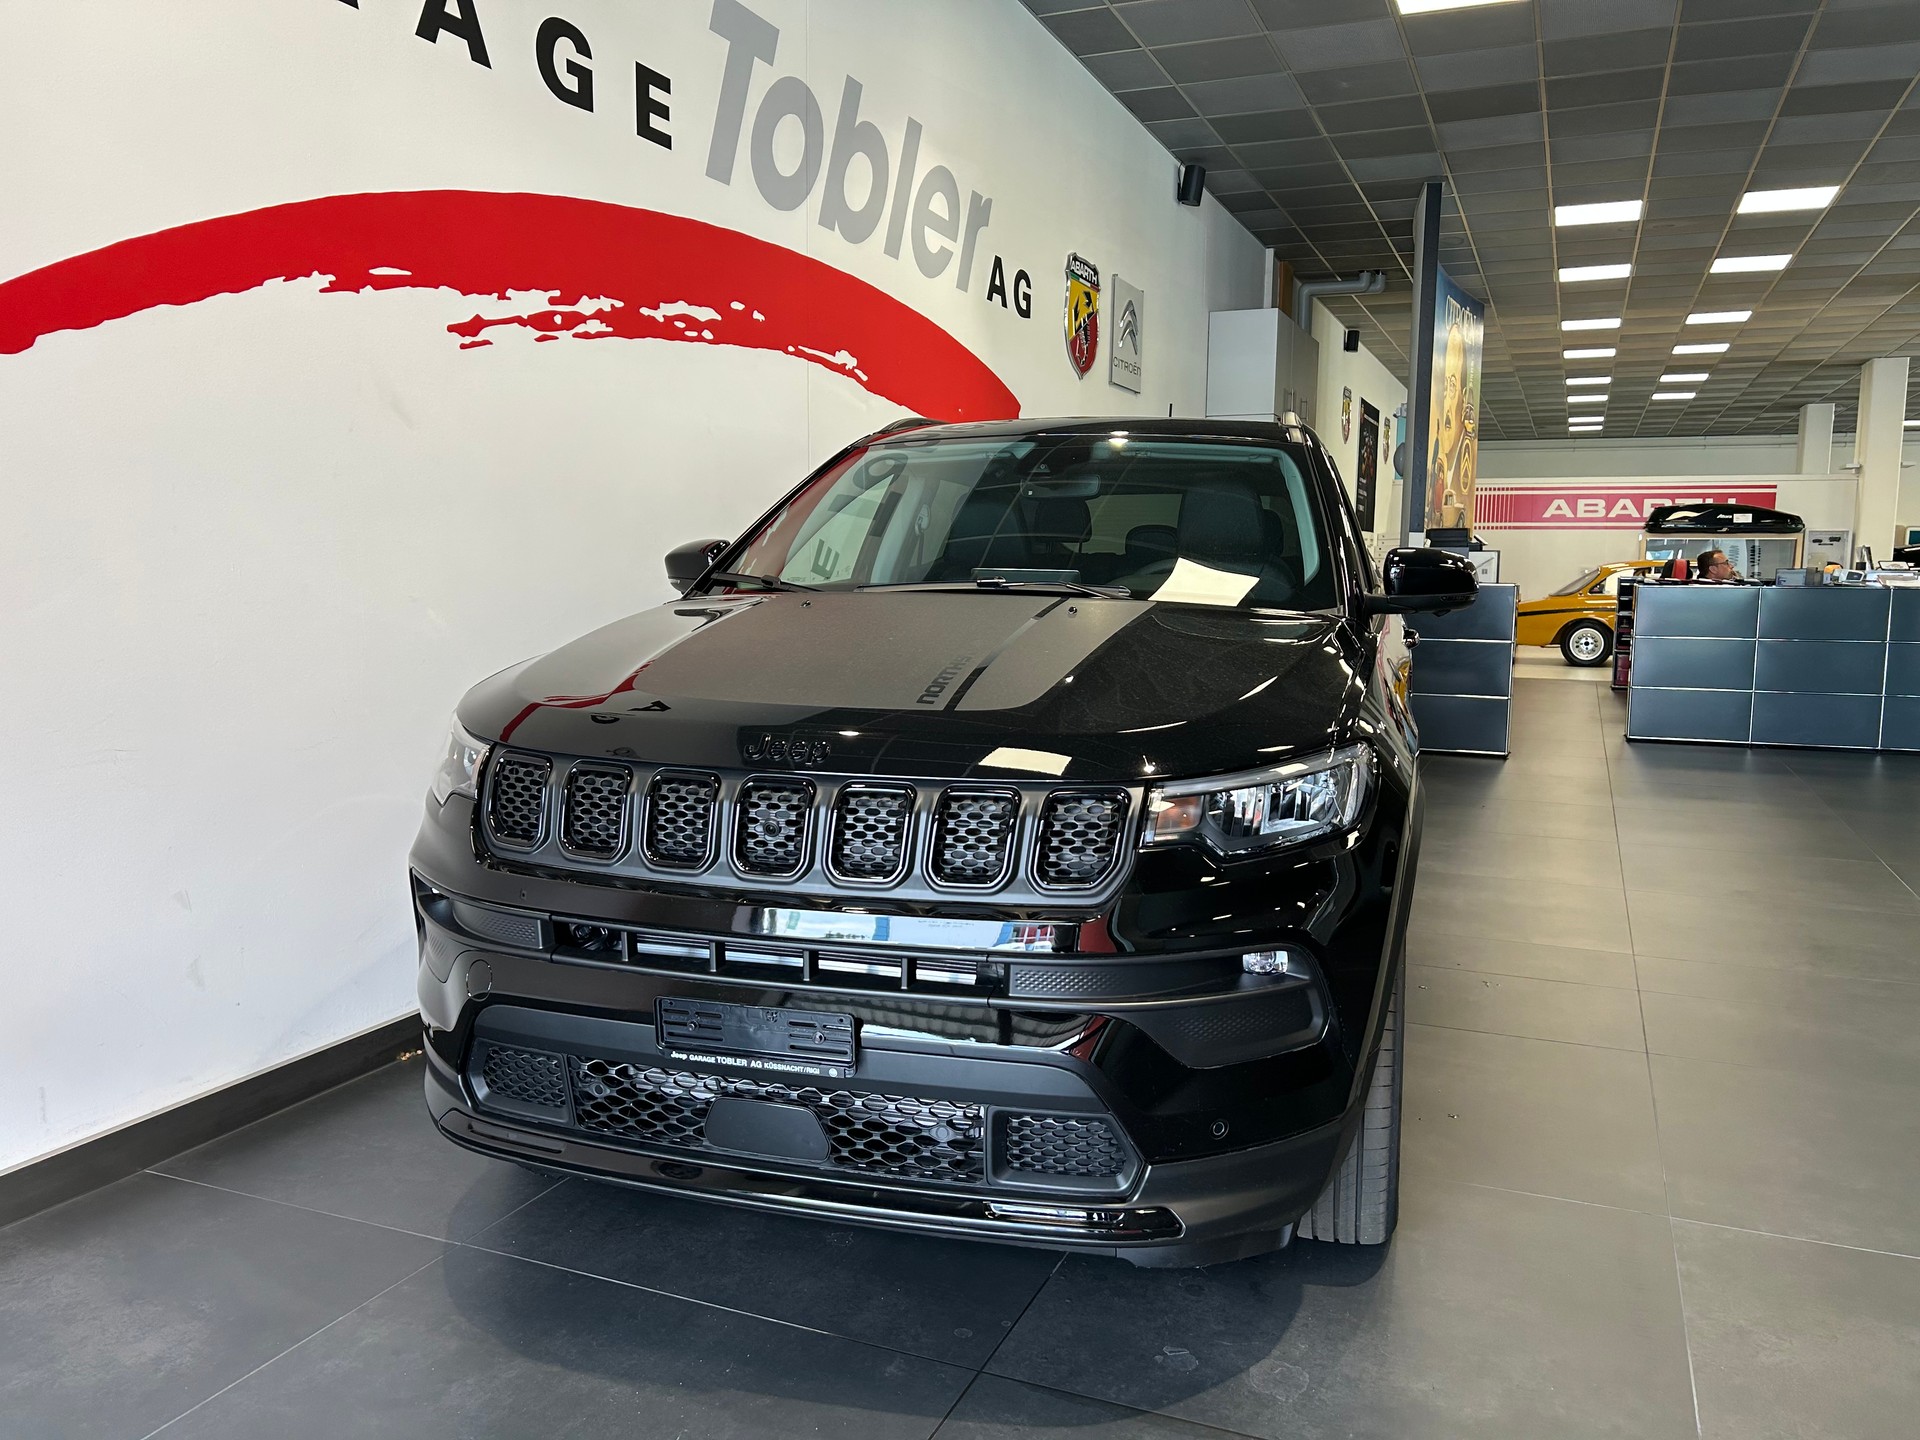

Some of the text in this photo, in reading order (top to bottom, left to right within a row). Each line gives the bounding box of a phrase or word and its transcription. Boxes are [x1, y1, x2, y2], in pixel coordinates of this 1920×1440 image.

[338, 0, 1031, 319] AGE Tobler AG
[1070, 260, 1098, 285] ABARTH
[1542, 498, 1737, 518] ABAR
[743, 732, 832, 768] Jeep
[670, 1051, 688, 1061] Jeep
[689, 1054, 715, 1064] GARAGE
[716, 1056, 748, 1067] TOBLER
[750, 1060, 763, 1069] AG
